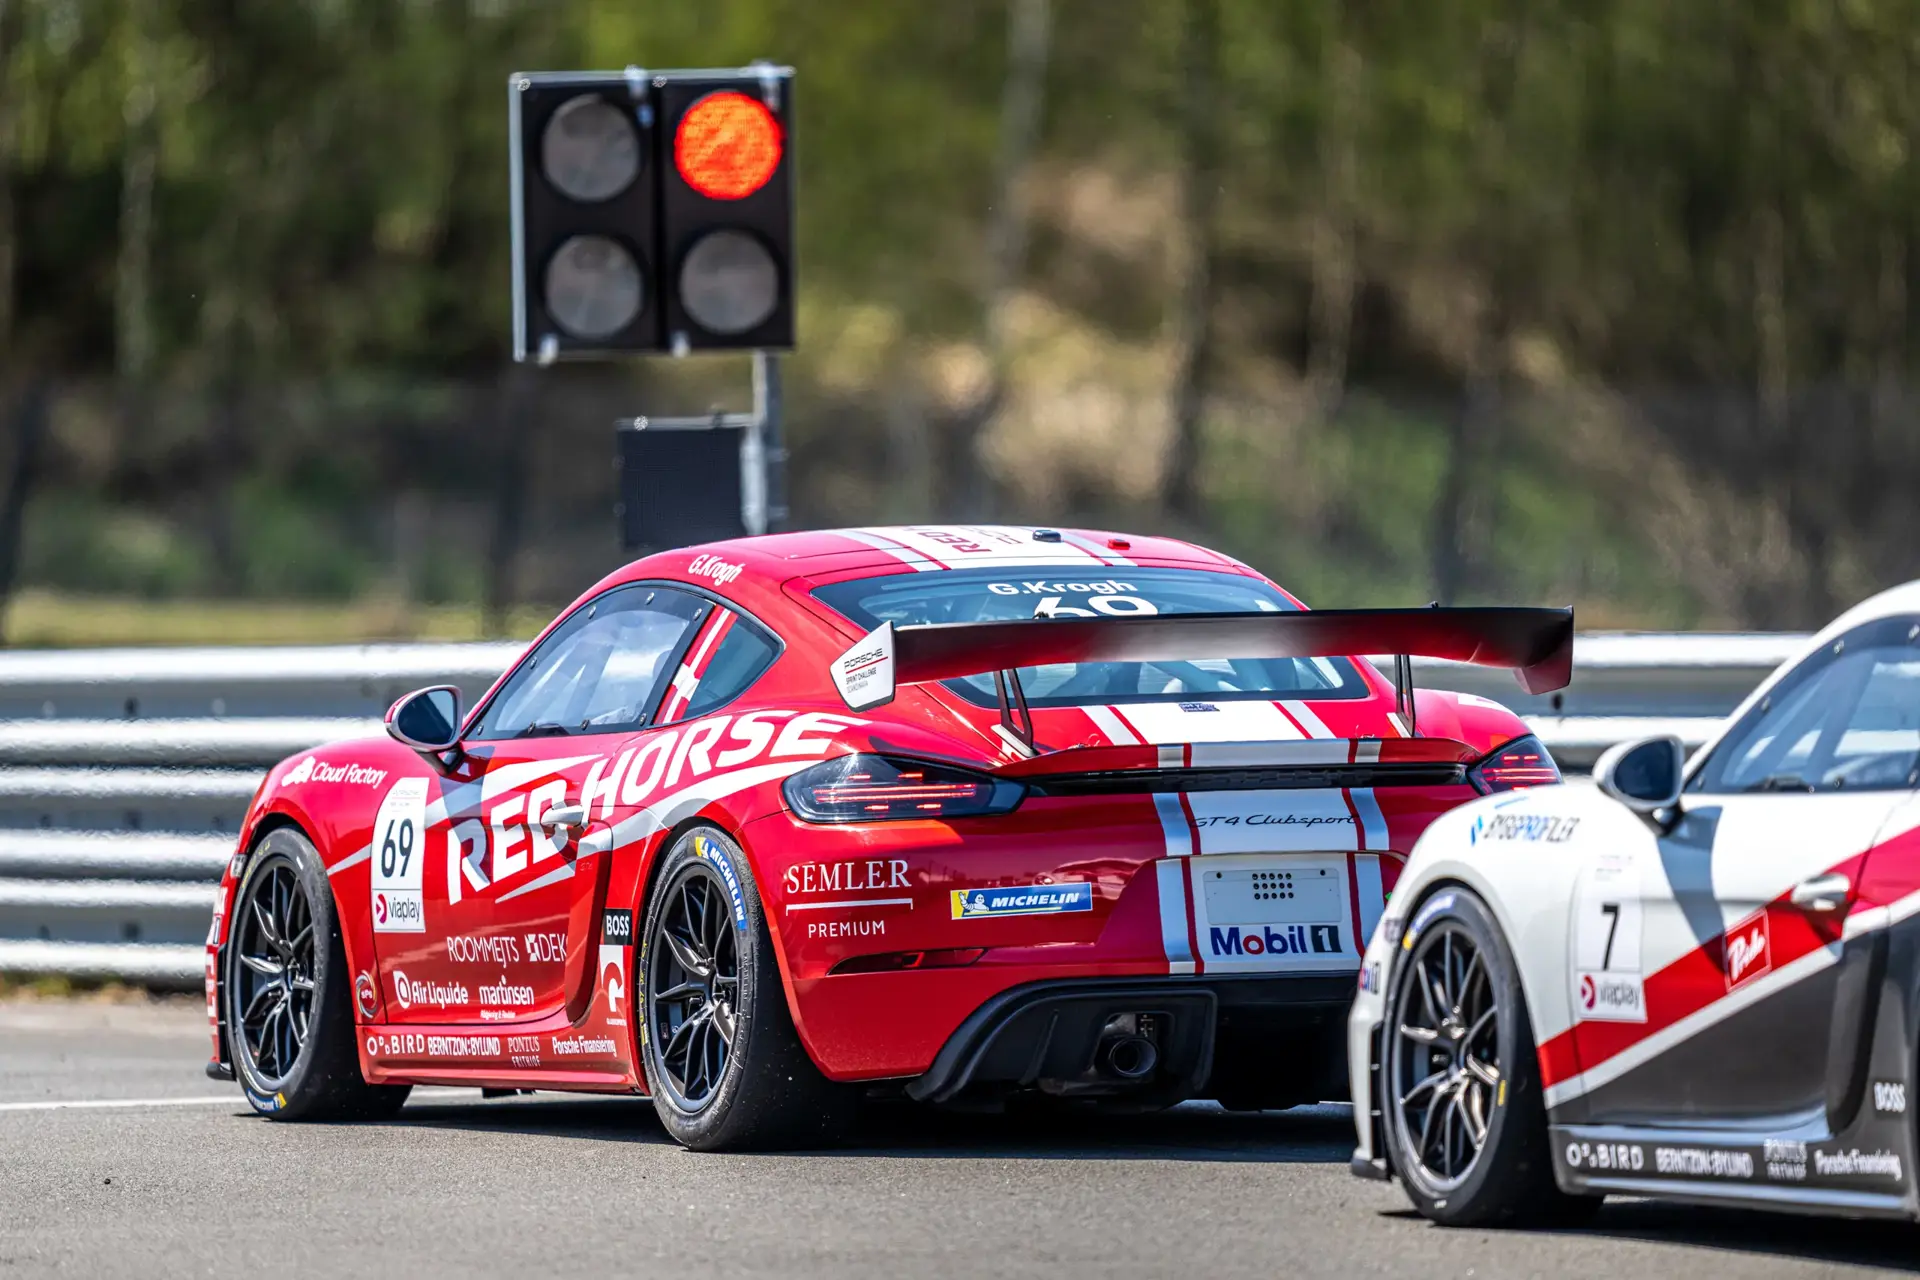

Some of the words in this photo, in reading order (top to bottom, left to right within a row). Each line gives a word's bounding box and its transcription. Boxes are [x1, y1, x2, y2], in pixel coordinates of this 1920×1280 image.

[987, 579, 1139, 595] G.Krogh
[844, 647, 884, 670] PORSCHE
[311, 762, 345, 783] Cloud
[345, 764, 388, 790] Factory
[581, 710, 873, 819] HORSE
[1190, 816, 1240, 828] GT4
[1245, 814, 1357, 829] Clubsport
[381, 818, 414, 878] 69
[709, 847, 745, 921] MICHELIN
[389, 897, 421, 923] viaplay
[991, 892, 1080, 908] MICHELIN
[606, 914, 630, 936] BOSS
[808, 920, 885, 938] PREMIUM
[1602, 903, 1620, 972] 7
[538, 933, 568, 962] DEK
[1210, 925, 1308, 956] Mobil
[412, 981, 427, 1004] Air
[427, 981, 469, 1009] Liquide
[479, 974, 534, 1005] martinsen
[508, 1036, 540, 1052] PONTUS
[552, 1035, 579, 1055] Porsche
